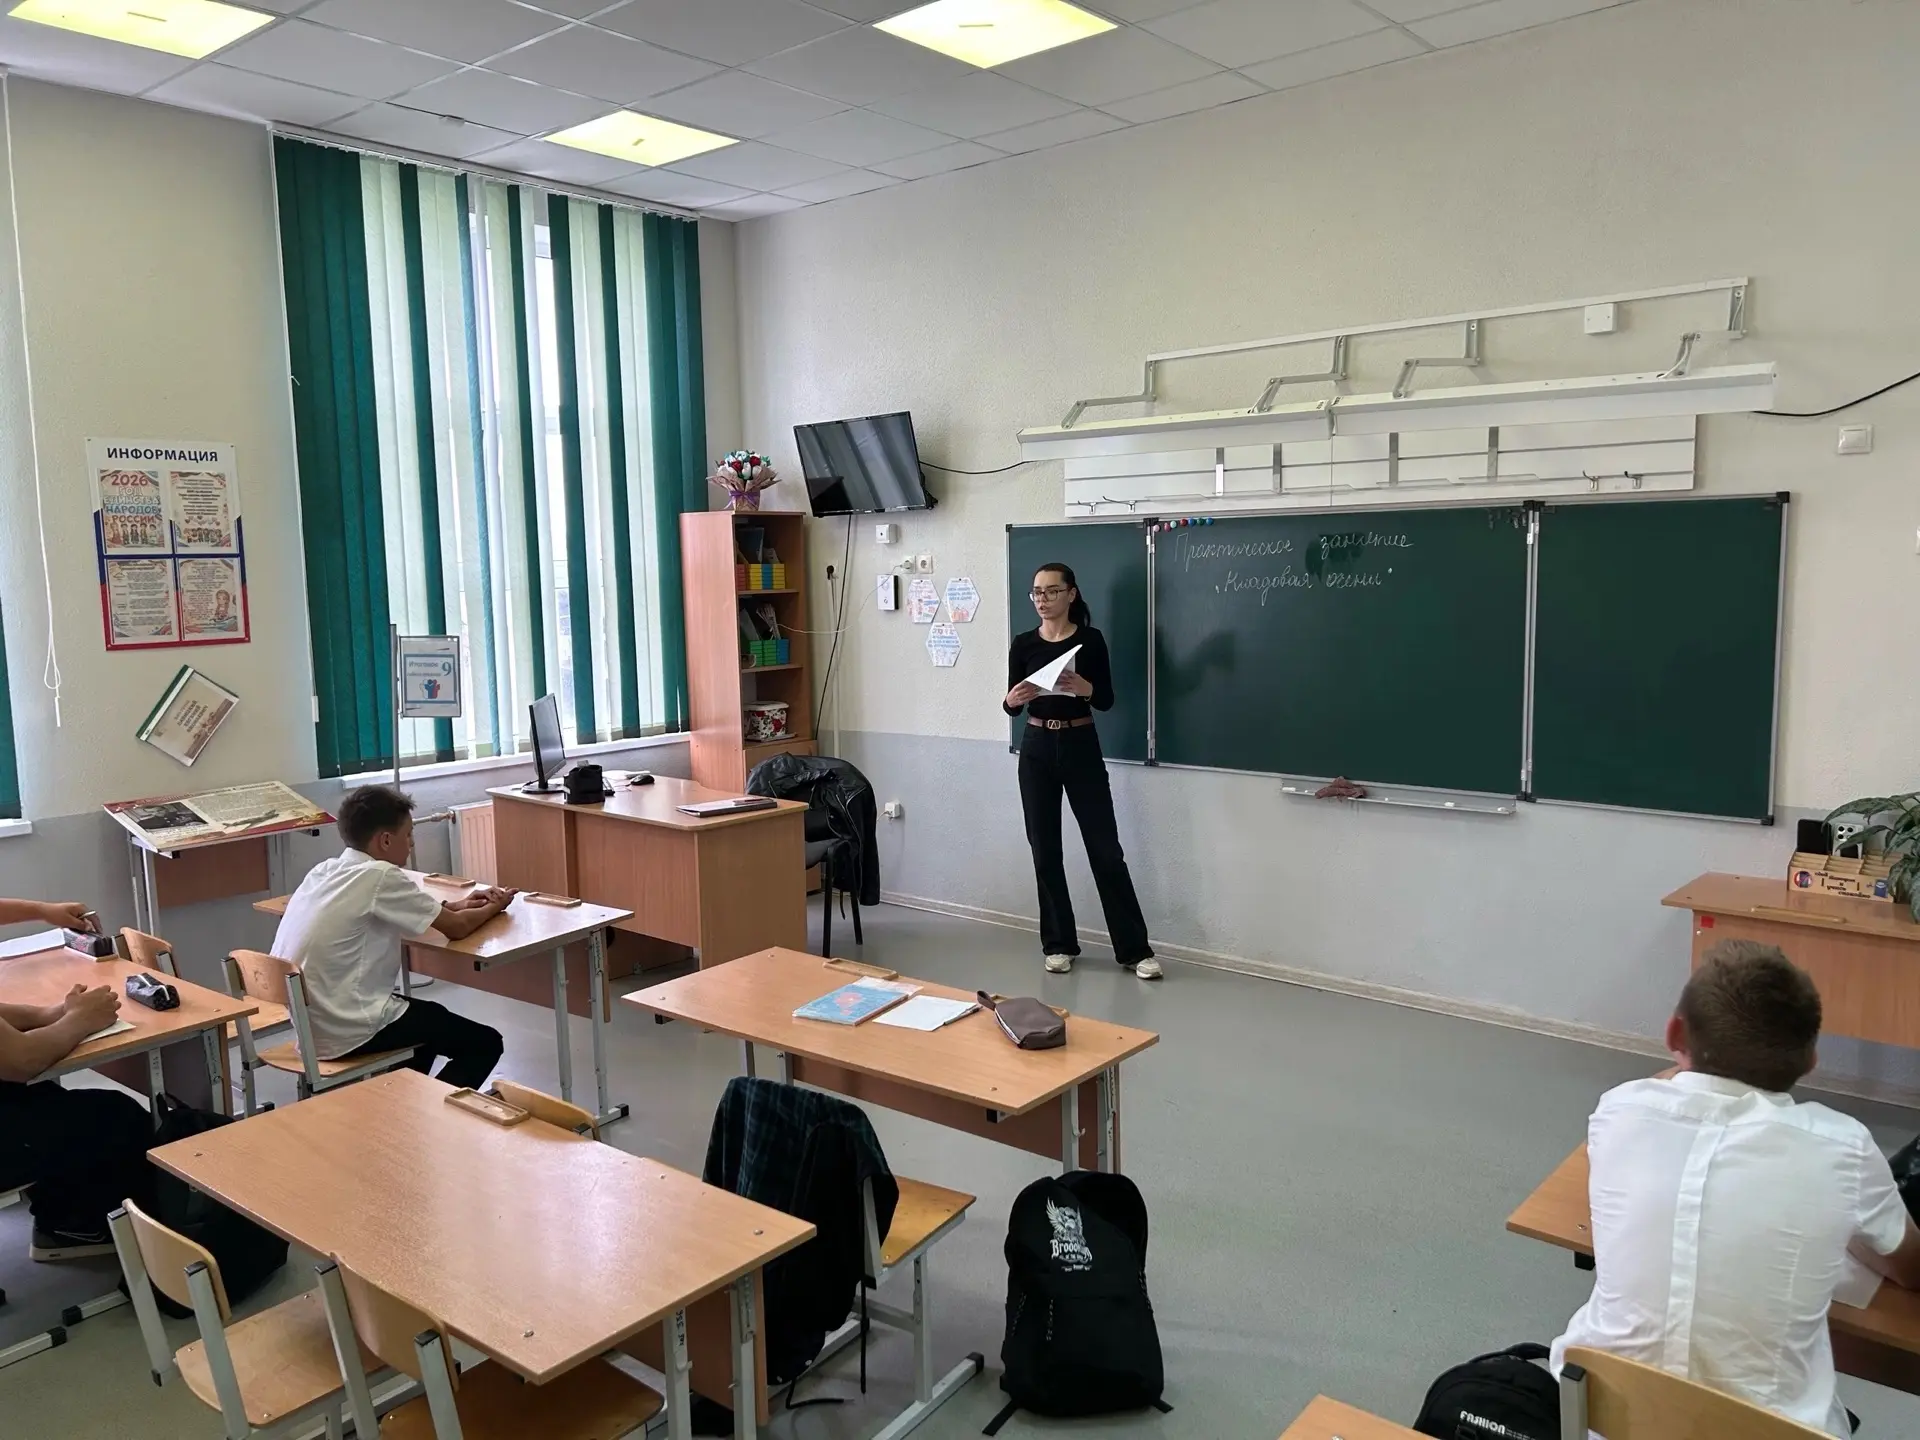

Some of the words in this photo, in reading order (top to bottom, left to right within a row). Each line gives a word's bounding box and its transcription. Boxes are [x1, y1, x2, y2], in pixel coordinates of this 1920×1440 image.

[107, 447, 218, 463] ИНФОРМАЦИЯ
[111, 474, 148, 486] 2026
[106, 505, 158, 514] НАРОДОВ
[112, 515, 154, 523] РОССИИ
[1174, 532, 1294, 572] Практическое
[1320, 531, 1415, 560] занятие
[442, 661, 452, 676] 9
[1460, 1410, 1506, 1435] FASHION
